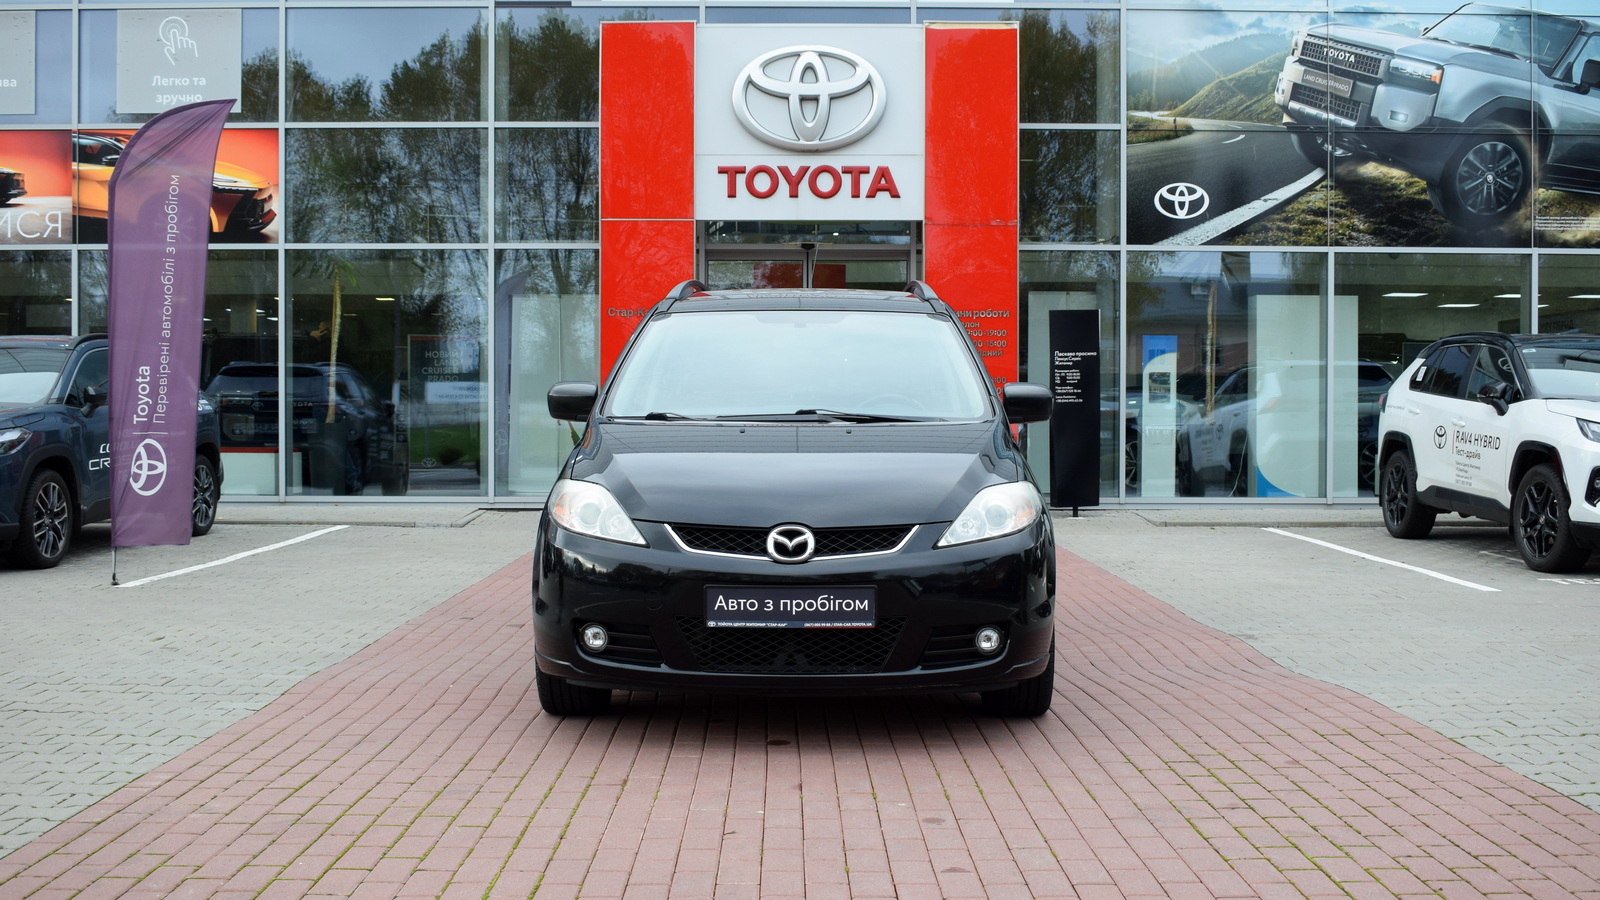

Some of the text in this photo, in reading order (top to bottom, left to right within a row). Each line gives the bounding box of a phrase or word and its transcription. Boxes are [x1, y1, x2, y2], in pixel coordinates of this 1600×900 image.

[1323, 48, 1354, 62] TOYOTA
[0, 79, 17, 88] ва
[151, 75, 207, 88] Легко та
[155, 93, 202, 105] зручно
[717, 165, 901, 199] TOYOTA
[153, 174, 181, 425] Перевірені автомобілі з пробігом
[973, 308, 1010, 320] роботи
[421, 366, 459, 375] CRUISER
[133, 365, 153, 425] Toyota
[1455, 430, 1501, 451] RAV4 HYBRID
[1455, 446, 1481, 460] Тест-драйв
[714, 594, 869, 615] Авто з пробігом
